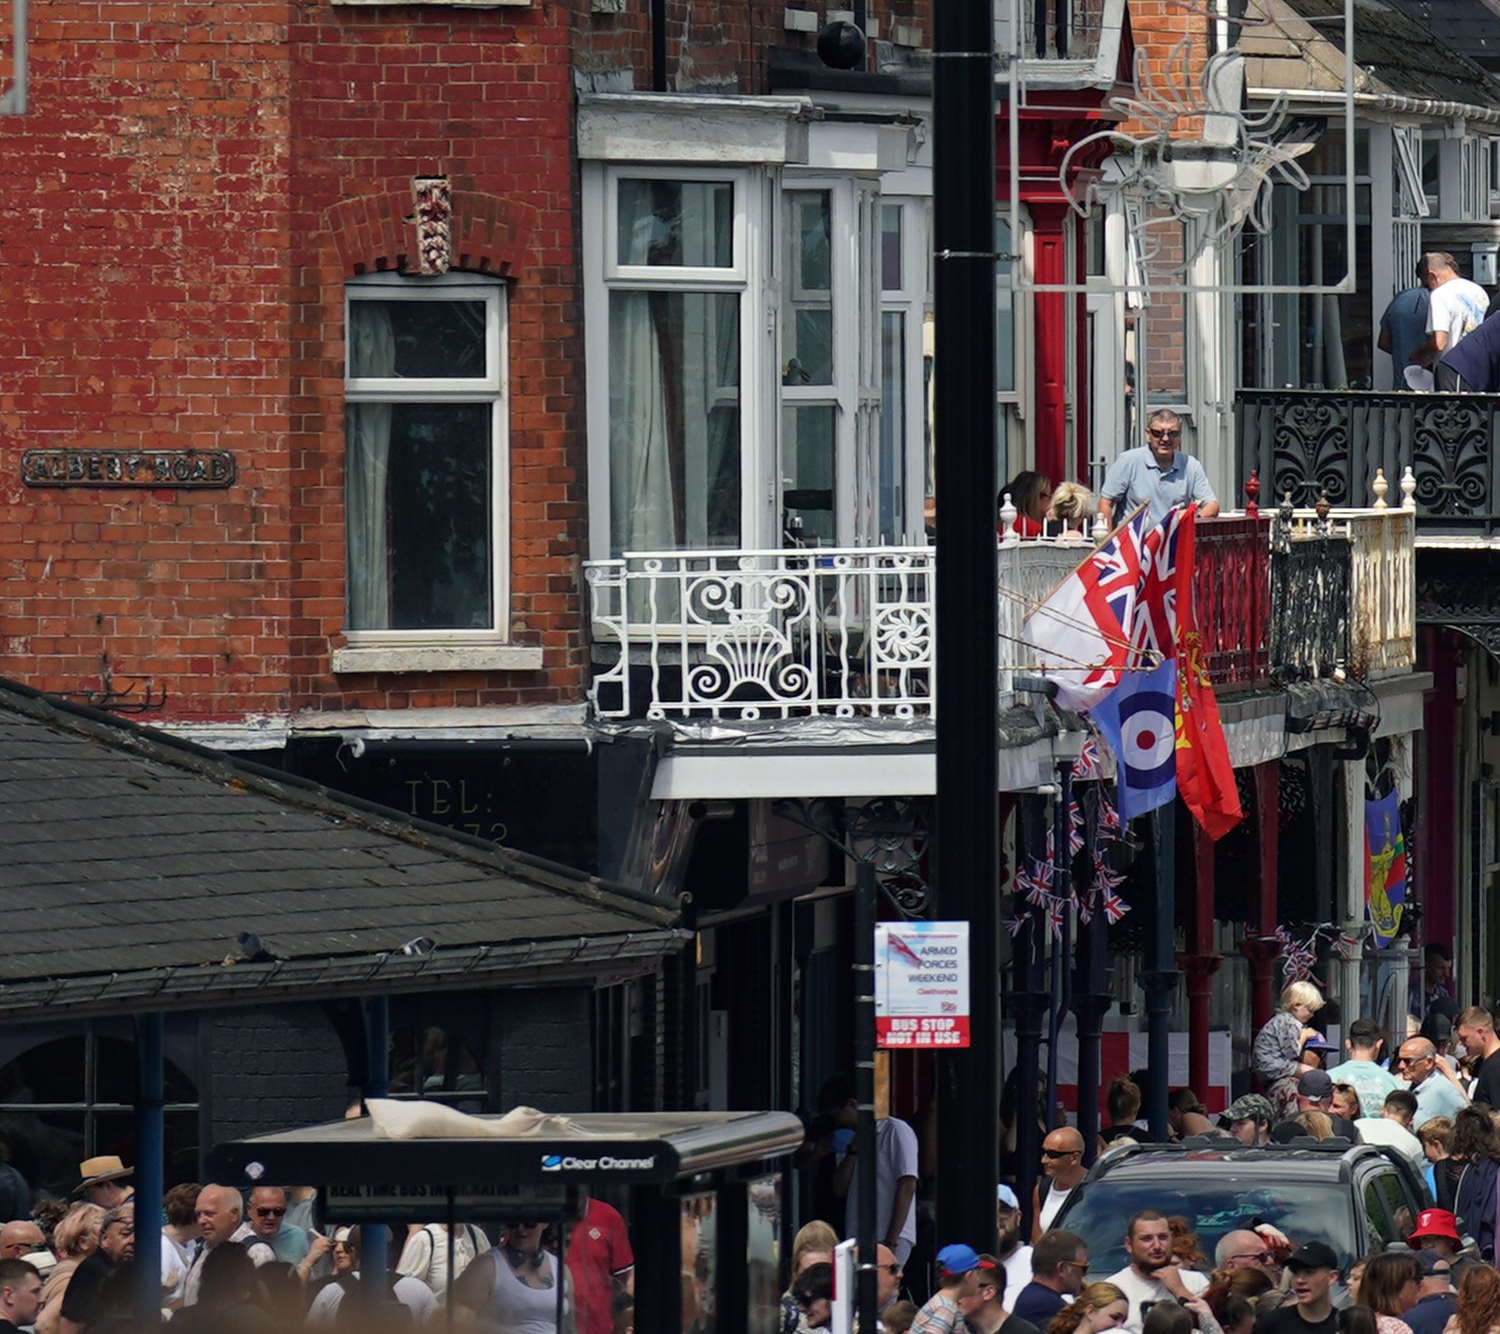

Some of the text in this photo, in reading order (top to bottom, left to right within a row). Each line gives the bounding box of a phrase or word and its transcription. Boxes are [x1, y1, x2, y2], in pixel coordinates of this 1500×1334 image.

[32, 456, 225, 481] ALBERT ROAD
[405, 779, 492, 815] TEL:
[921, 946, 958, 956] ARMED
[918, 959, 958, 969] FORCES
[908, 973, 958, 983] WEEKEND
[891, 1019, 955, 1031] BUS STOP
[886, 1032, 961, 1044] NOT IN USE
[562, 1156, 655, 1170] Clear Channel
